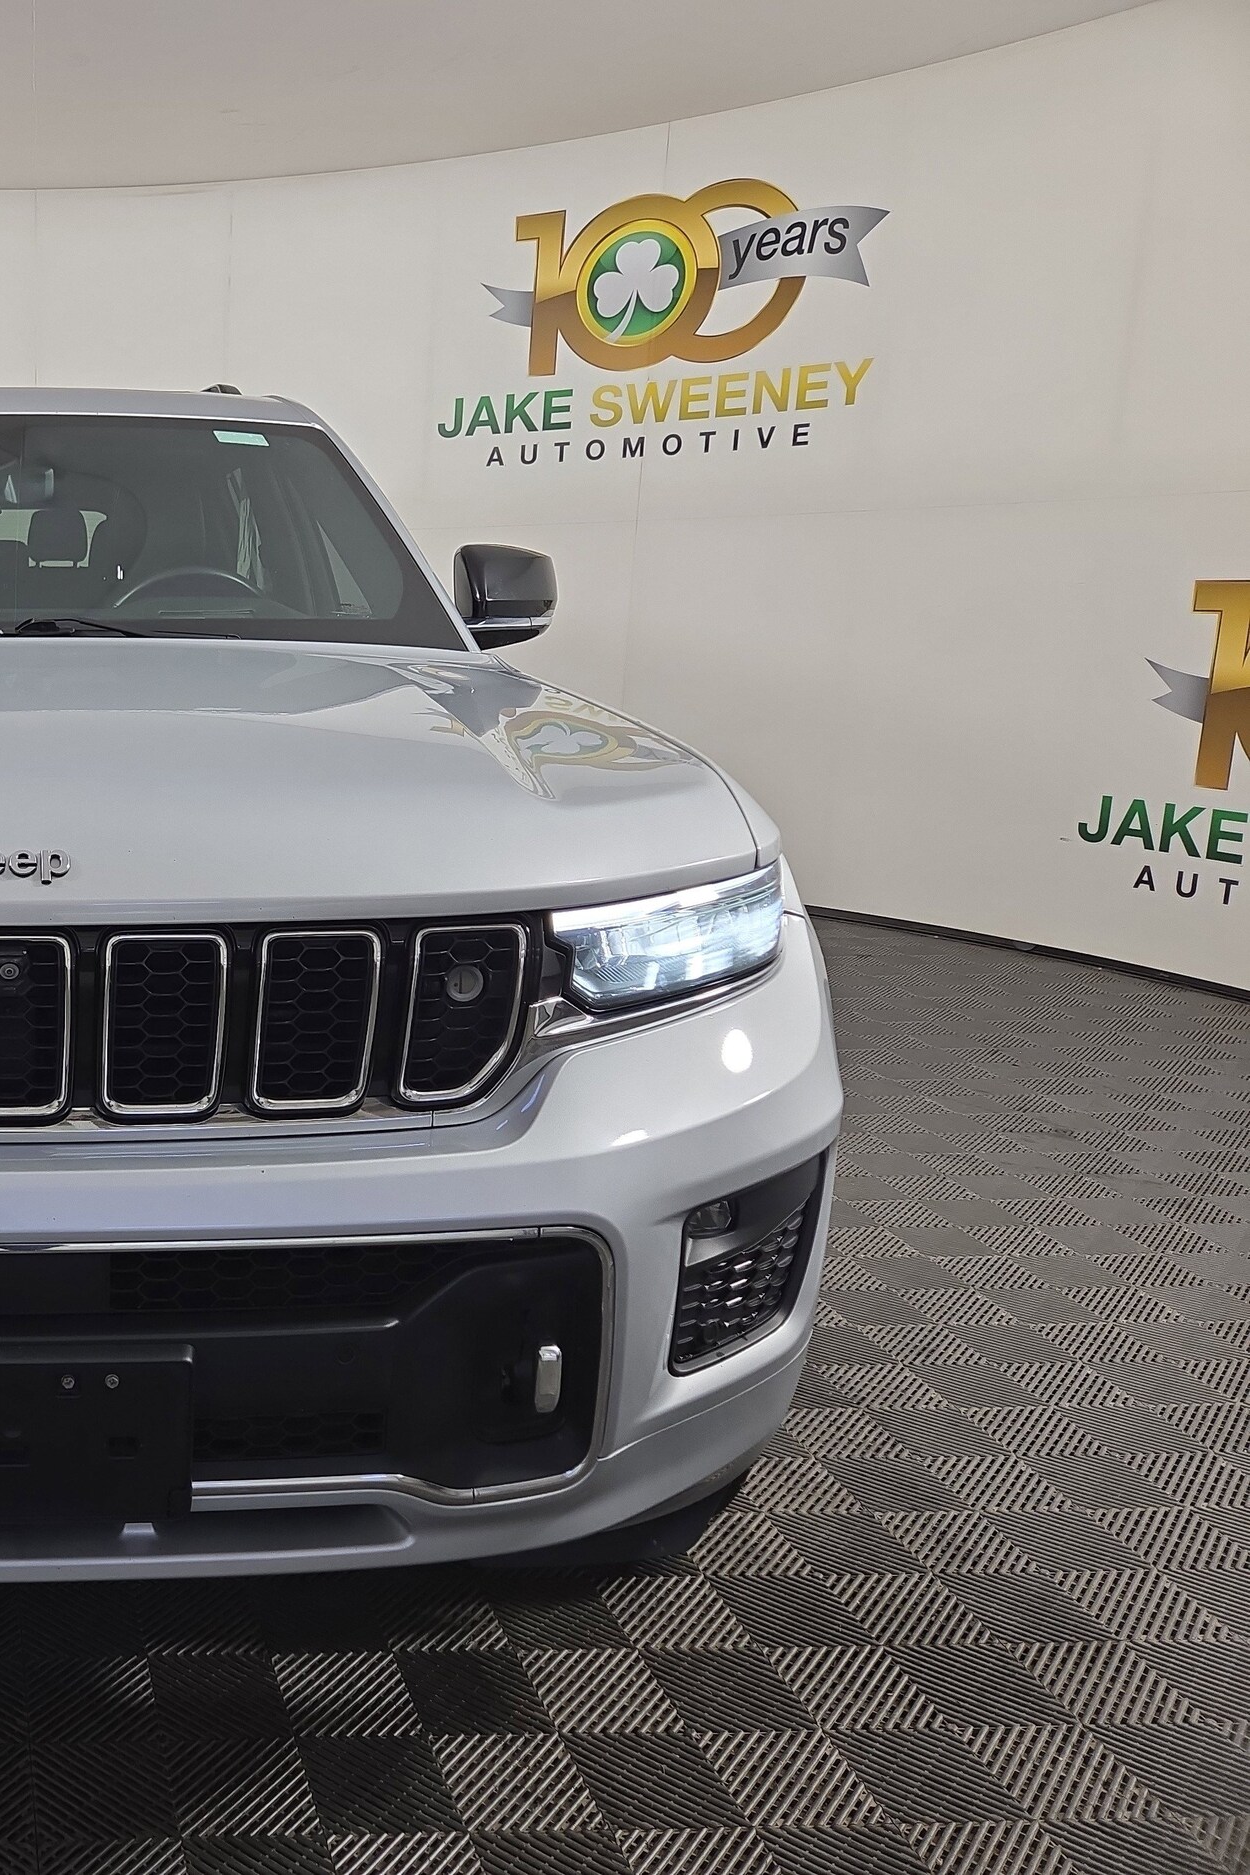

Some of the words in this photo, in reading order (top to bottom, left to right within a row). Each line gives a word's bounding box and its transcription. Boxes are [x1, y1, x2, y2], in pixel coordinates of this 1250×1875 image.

[515, 178, 807, 377] 100
[727, 215, 850, 280] years
[437, 388, 573, 439] JAKE
[589, 357, 874, 428] SWEENEY
[486, 422, 811, 467] AUTOMOTIVE
[1077, 795, 1249, 865] JAKE
[1133, 865, 1240, 906] AUT
